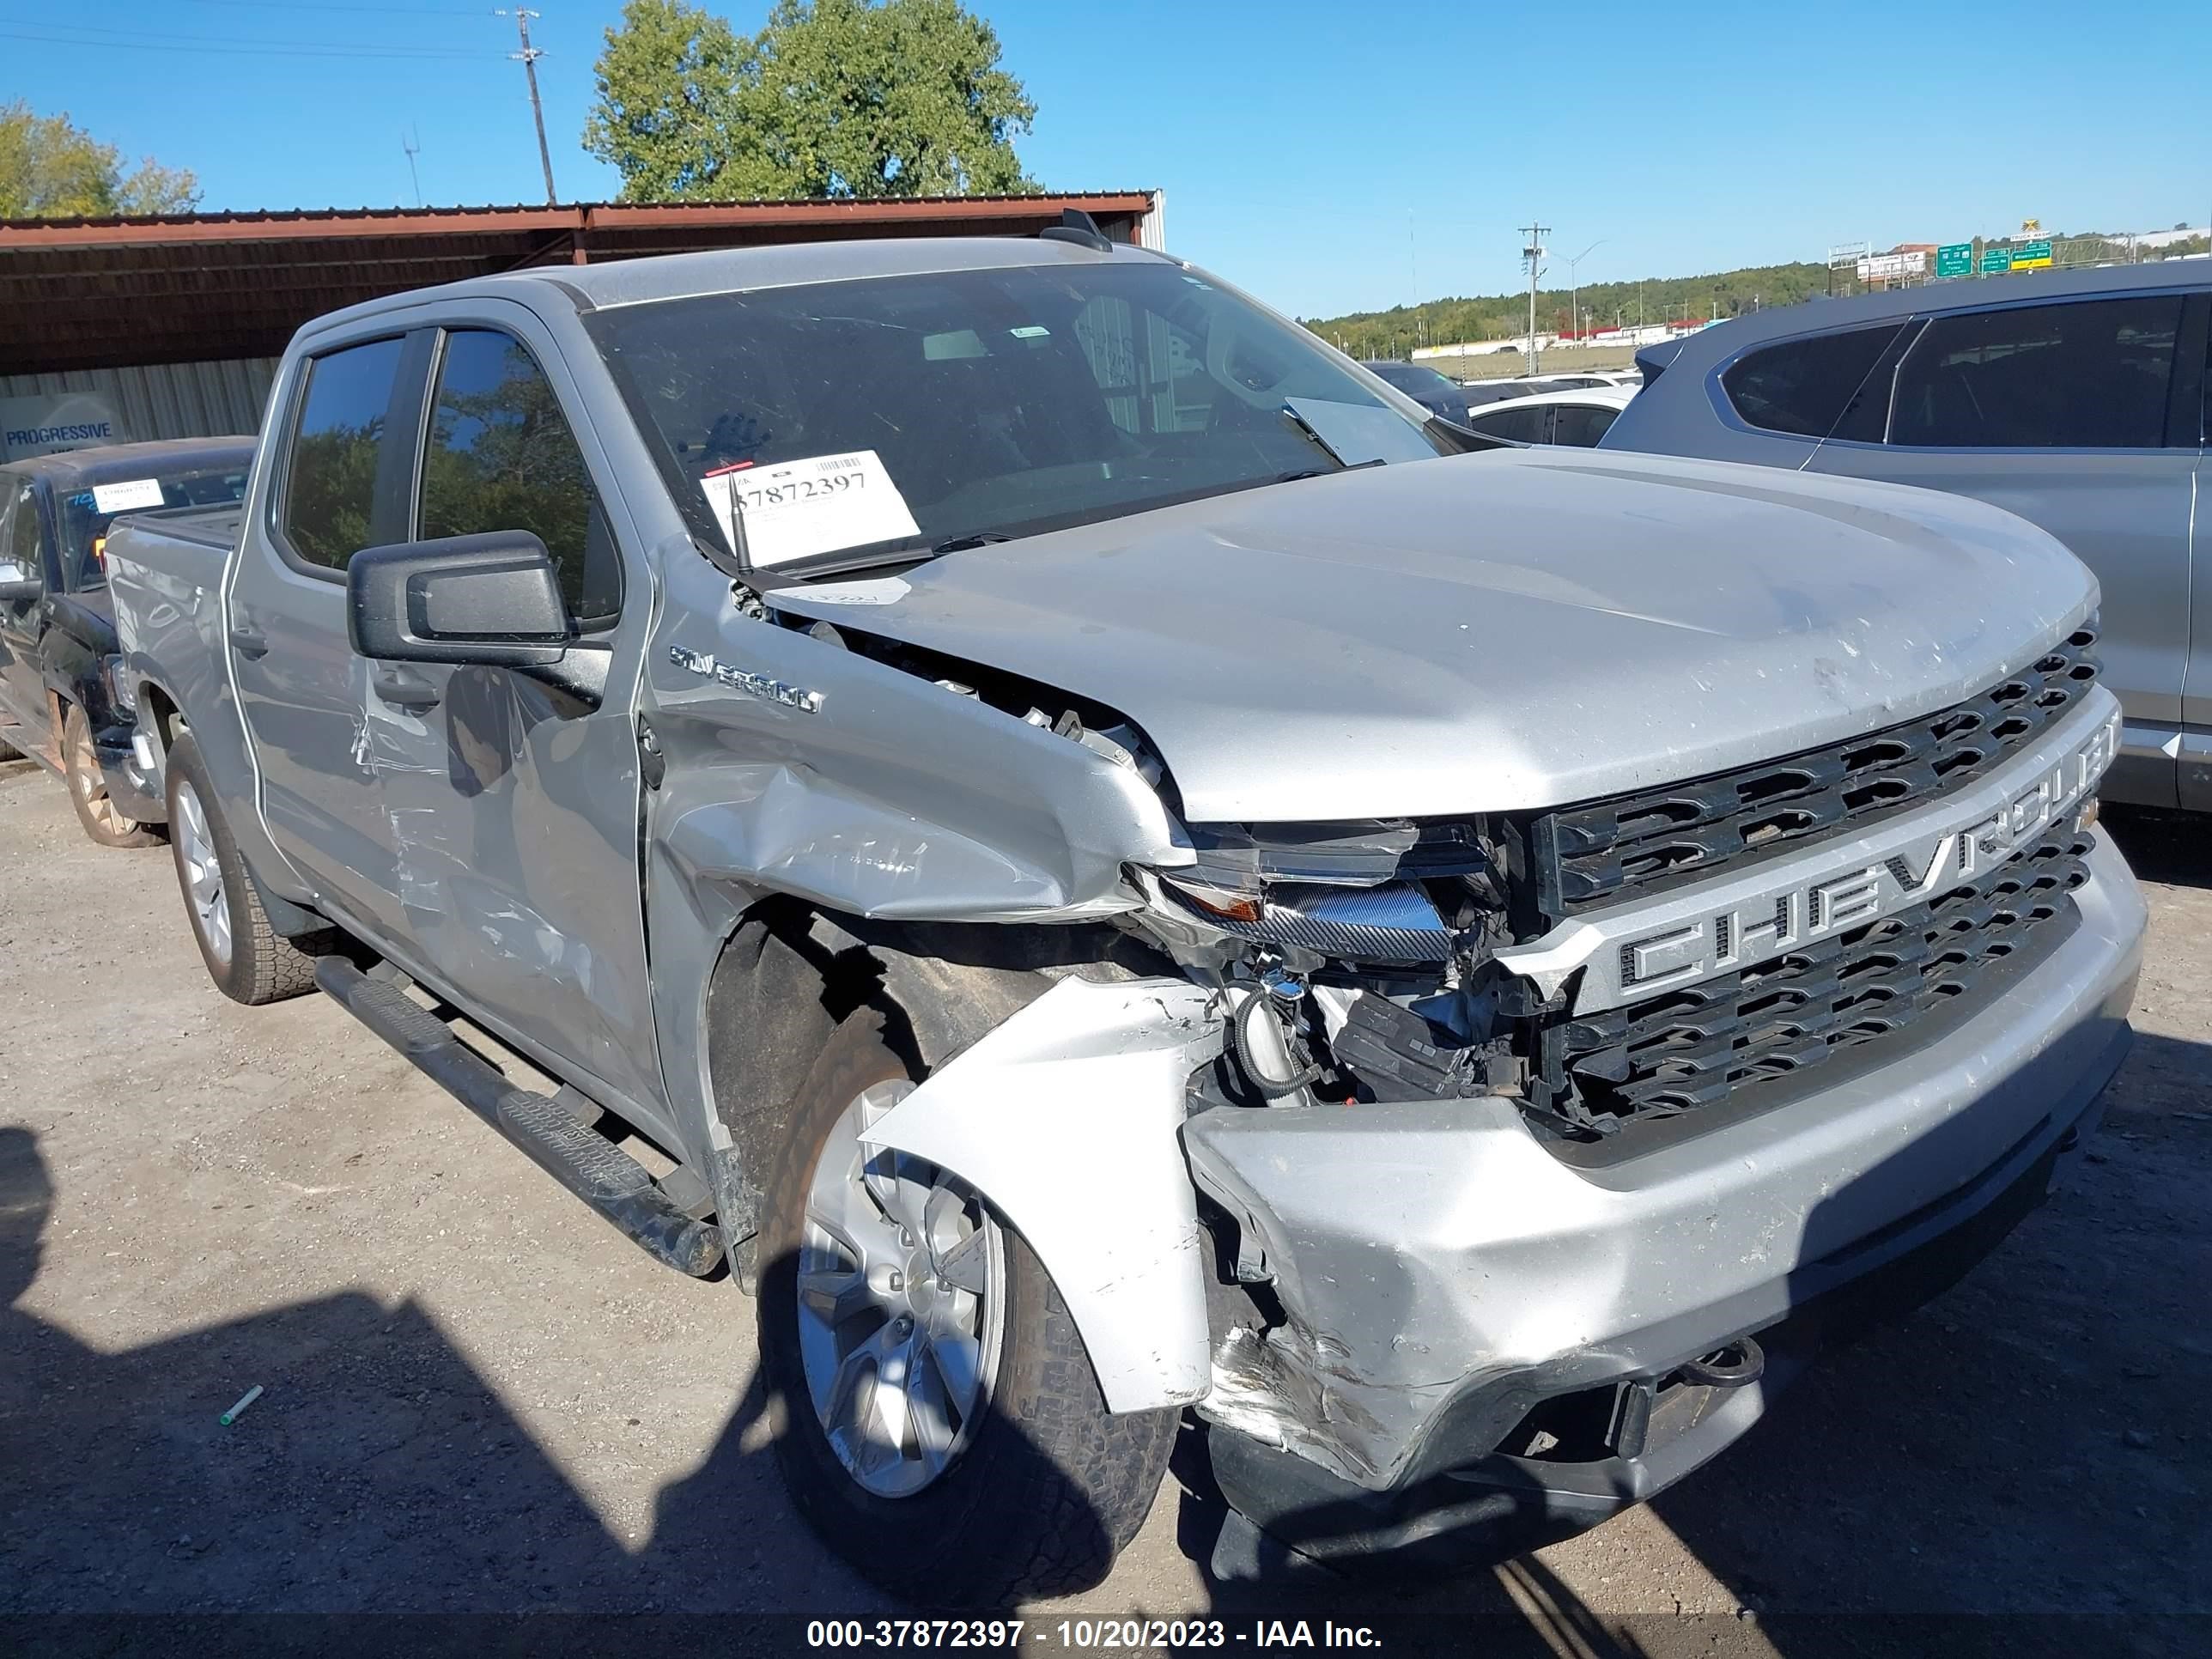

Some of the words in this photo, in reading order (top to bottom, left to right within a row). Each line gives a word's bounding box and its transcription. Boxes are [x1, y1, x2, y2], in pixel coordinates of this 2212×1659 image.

[7, 422, 112, 447] PROGRESSIVE
[669, 644, 824, 715] SILVERADO
[1620, 704, 2122, 996] CHEVROLET
